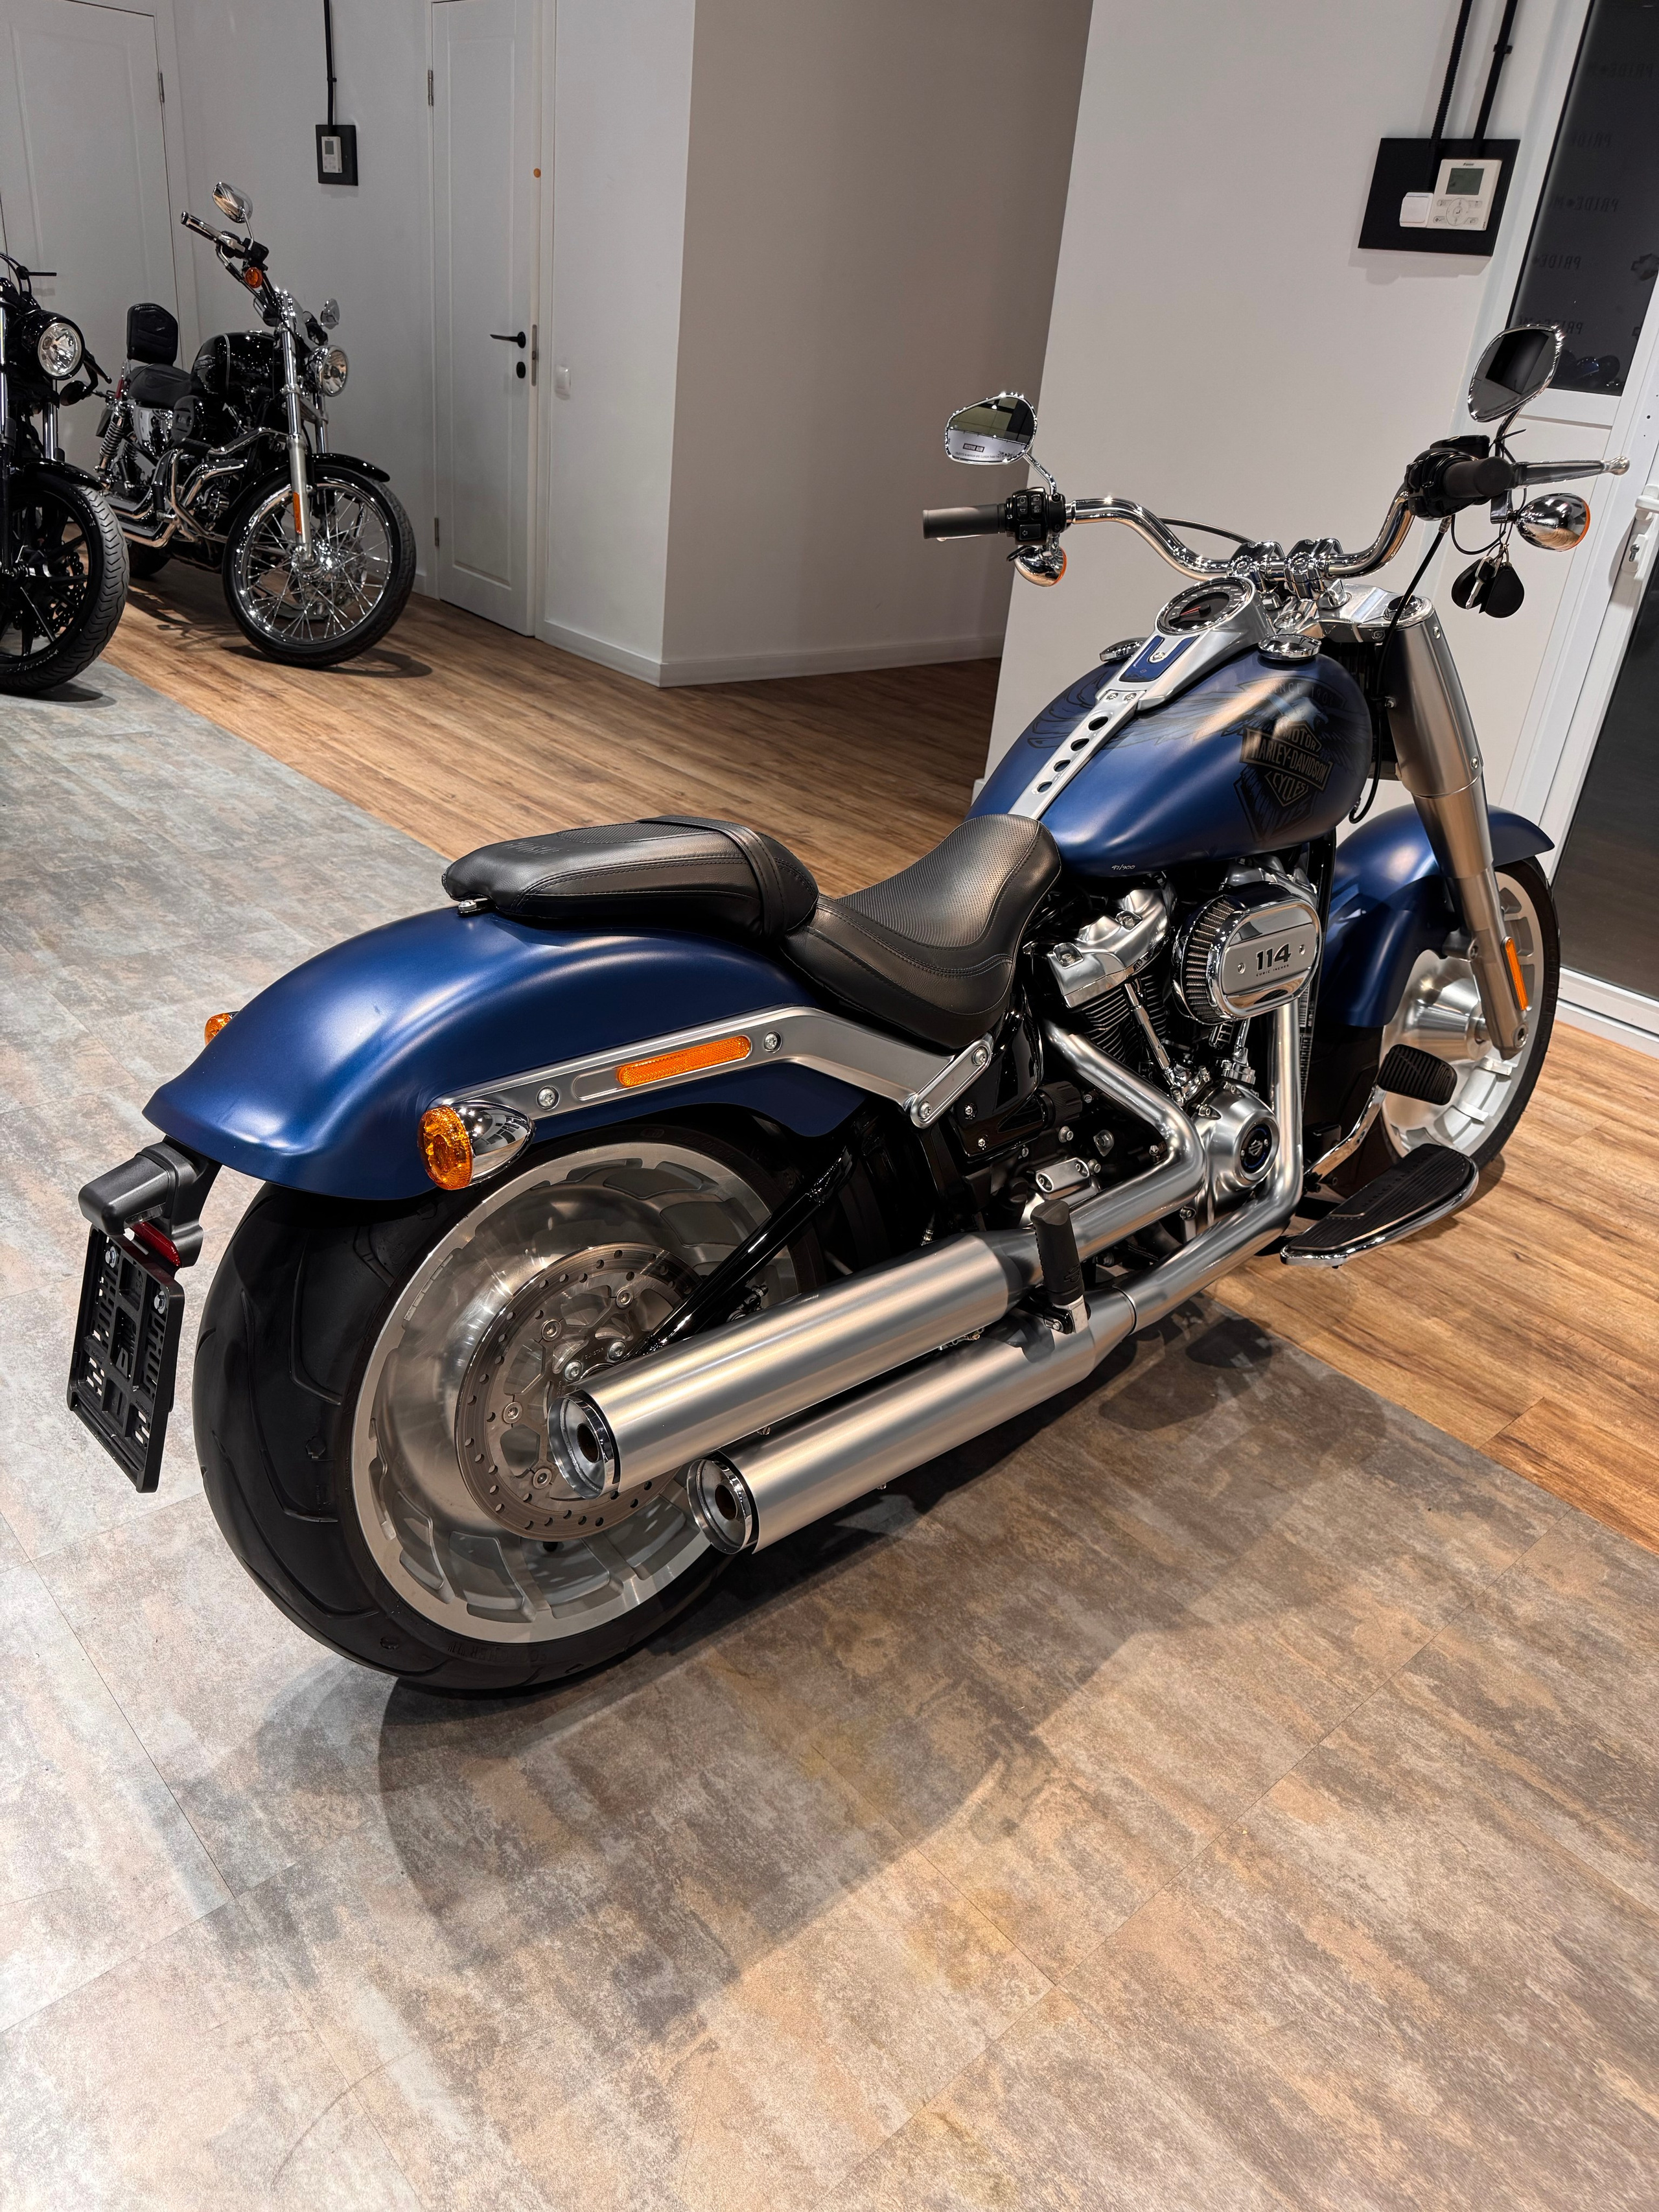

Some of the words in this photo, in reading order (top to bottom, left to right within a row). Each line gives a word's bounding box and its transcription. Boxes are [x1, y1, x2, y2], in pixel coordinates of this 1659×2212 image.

[1269, 682, 1302, 695] INCE
[1282, 727, 1317, 751] MOTOR
[1251, 737, 1328, 784] HARLEY-DAVIDSON
[1272, 772, 1306, 801] CYCLES
[1257, 943, 1292, 971] 114
